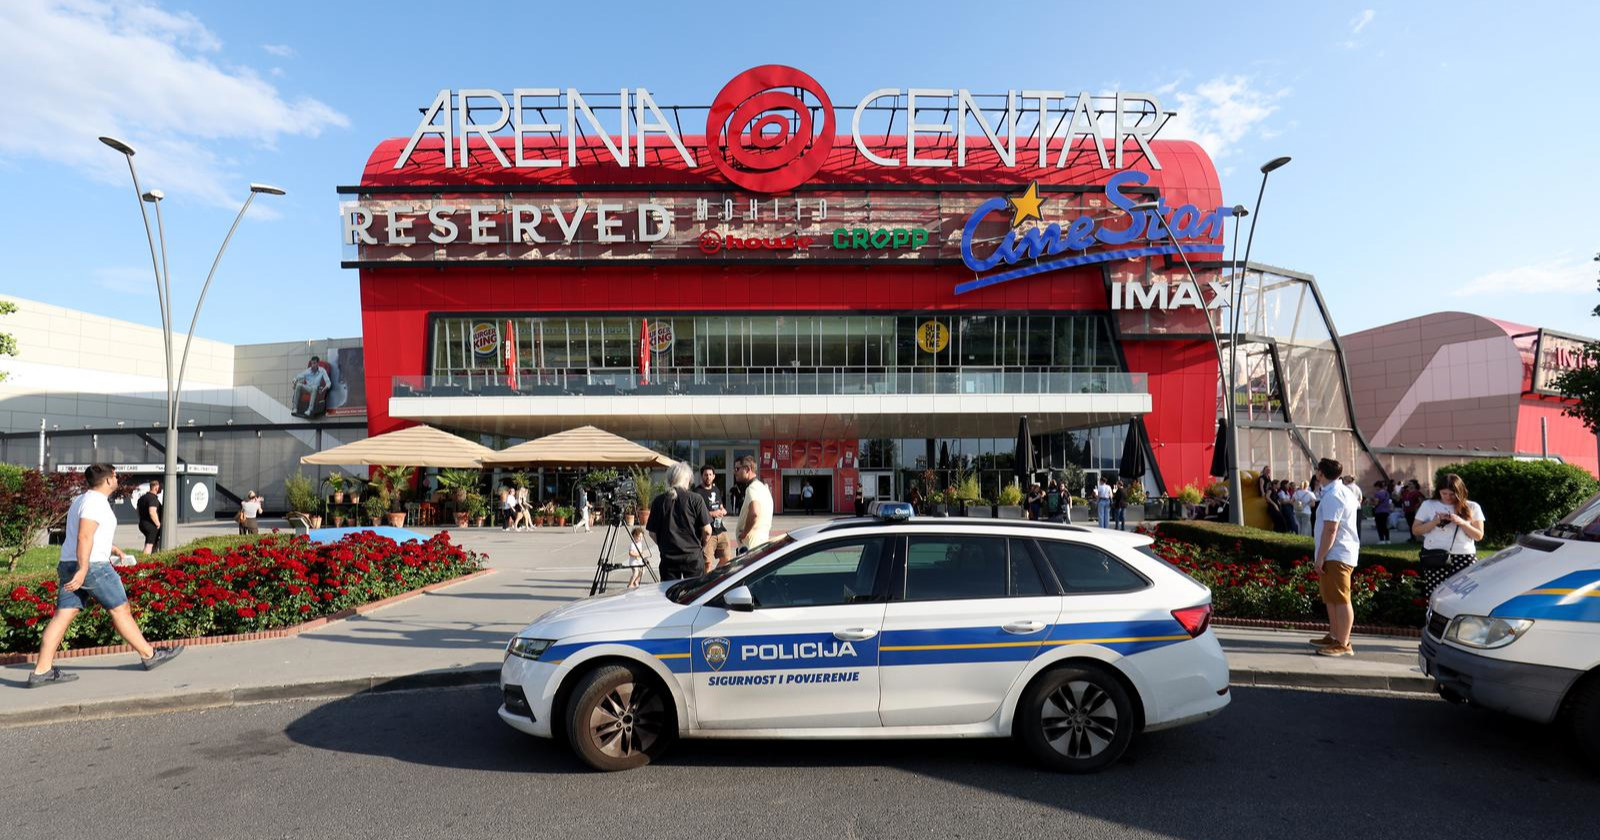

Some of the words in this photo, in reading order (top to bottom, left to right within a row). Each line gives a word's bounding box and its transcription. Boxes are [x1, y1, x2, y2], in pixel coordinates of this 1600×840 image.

[394, 88, 697, 168] ARENA
[852, 88, 1161, 169] CENTAR
[697, 199, 827, 220] MOHITO
[344, 204, 671, 244] RESERVED
[726, 235, 814, 250] house
[833, 228, 928, 249] CROPP
[1112, 282, 1232, 309] IMAX
[741, 641, 858, 661] POLICIJA
[708, 675, 776, 686] SIGURNOST
[778, 674, 785, 684] I
[786, 672, 860, 684] POVJERENJE
